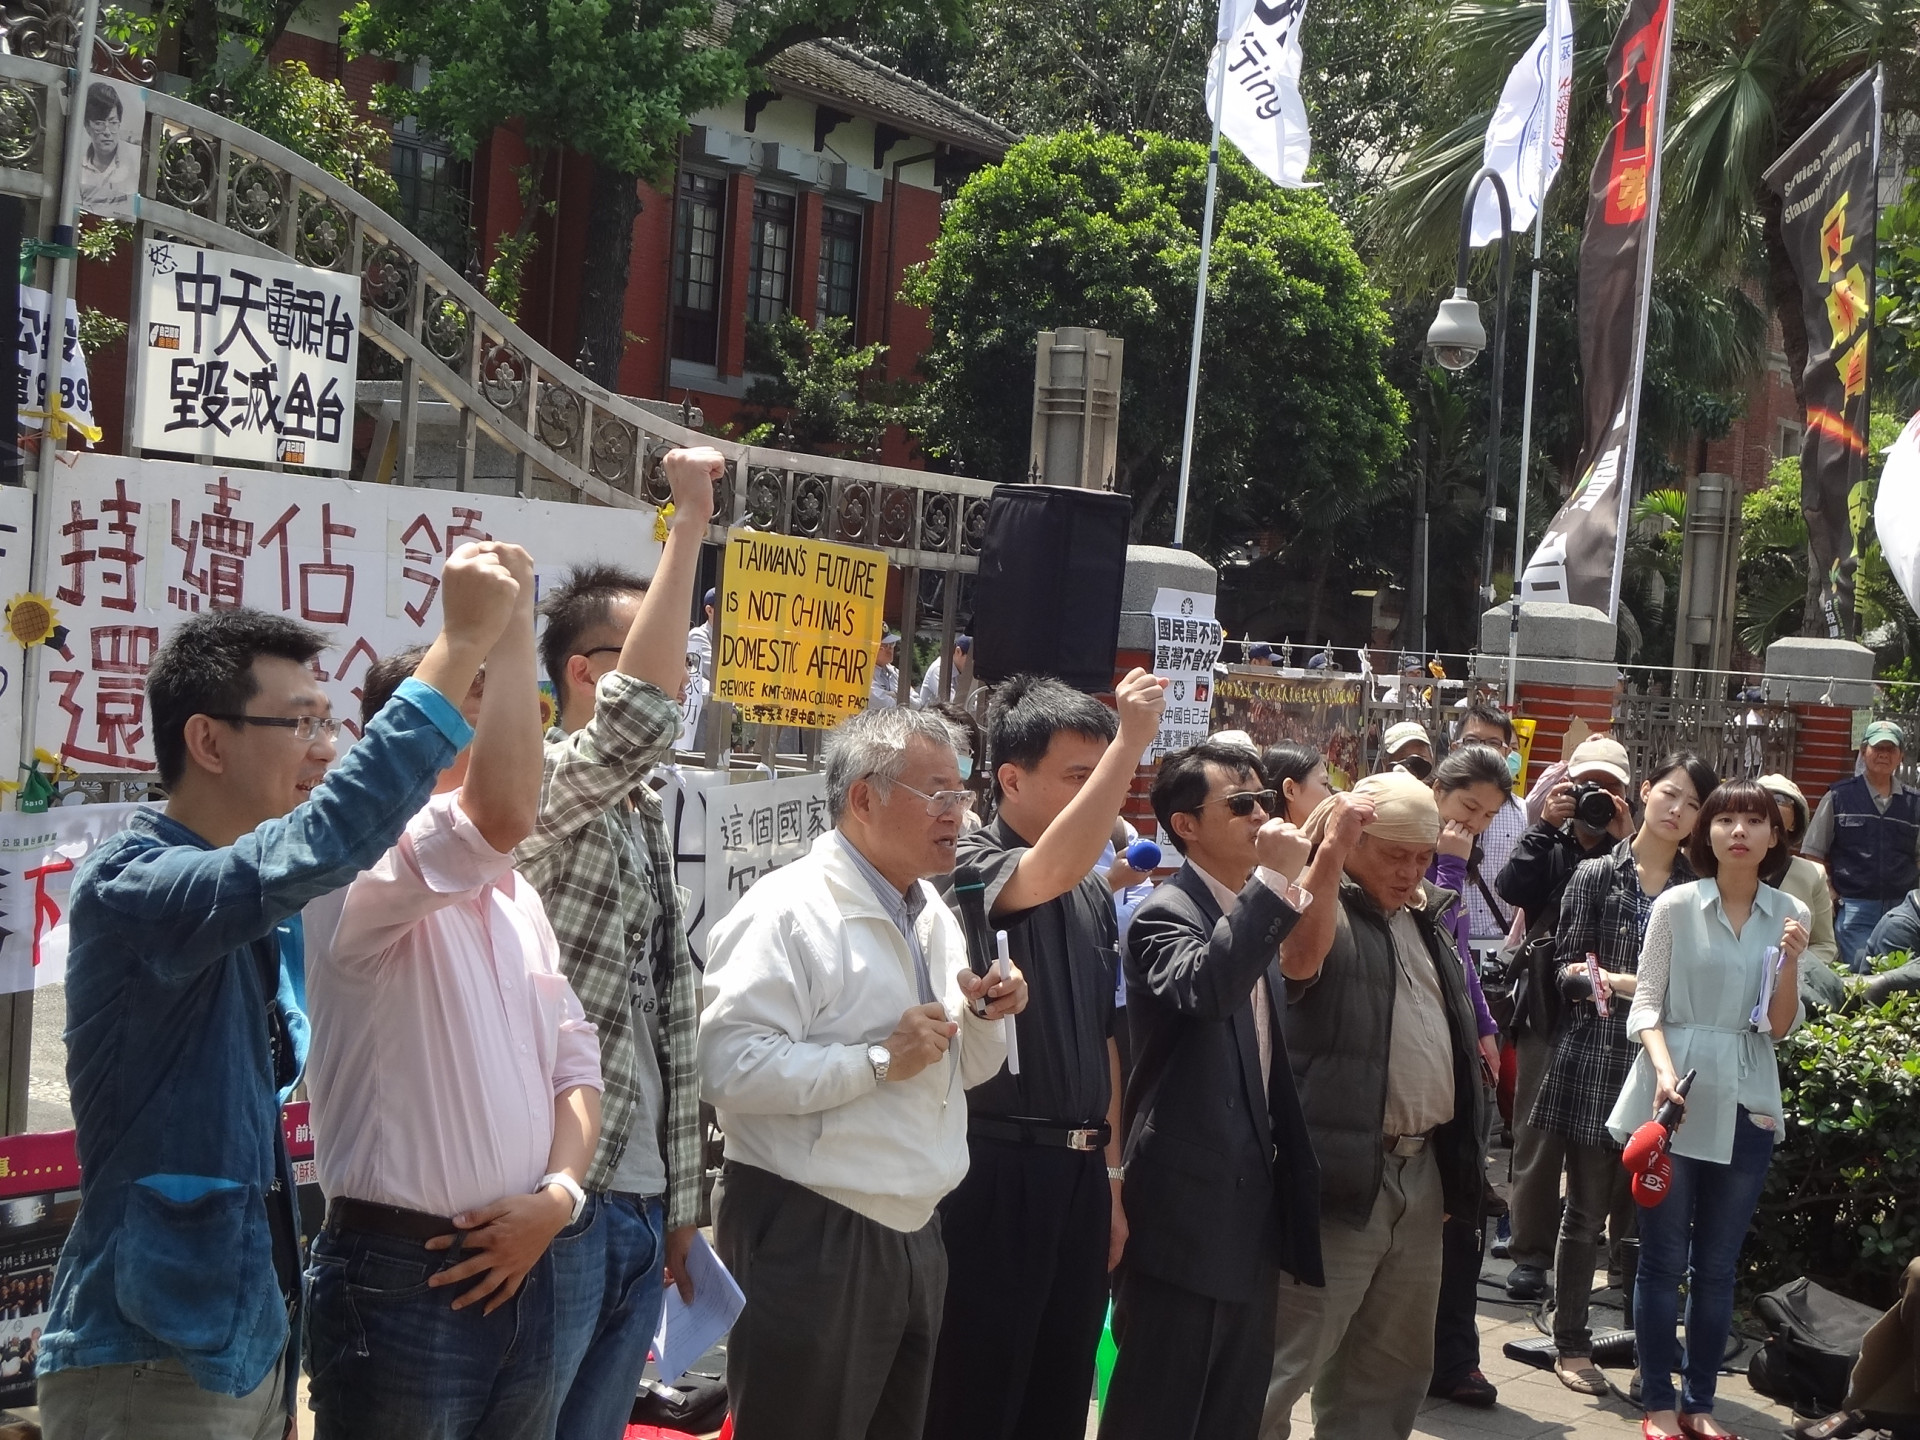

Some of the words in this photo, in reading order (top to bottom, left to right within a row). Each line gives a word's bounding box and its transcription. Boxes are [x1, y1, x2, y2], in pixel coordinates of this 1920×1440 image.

[56, 476, 493, 628] 持續佔領
[733, 538, 807, 577] TAIWAN'S
[815, 552, 877, 599] FUTURE
[726, 591, 738, 612] IS
[748, 590, 786, 622] NOT
[791, 593, 855, 636] CHINA'S
[1157, 616, 1221, 647] 國民黨不倒
[721, 634, 800, 674] DOMESTIC
[806, 645, 868, 685] AFFAIR
[1156, 644, 1218, 673] 臺灣不會好
[720, 680, 756, 698] REVOKE
[721, 795, 828, 852] 這個國家
